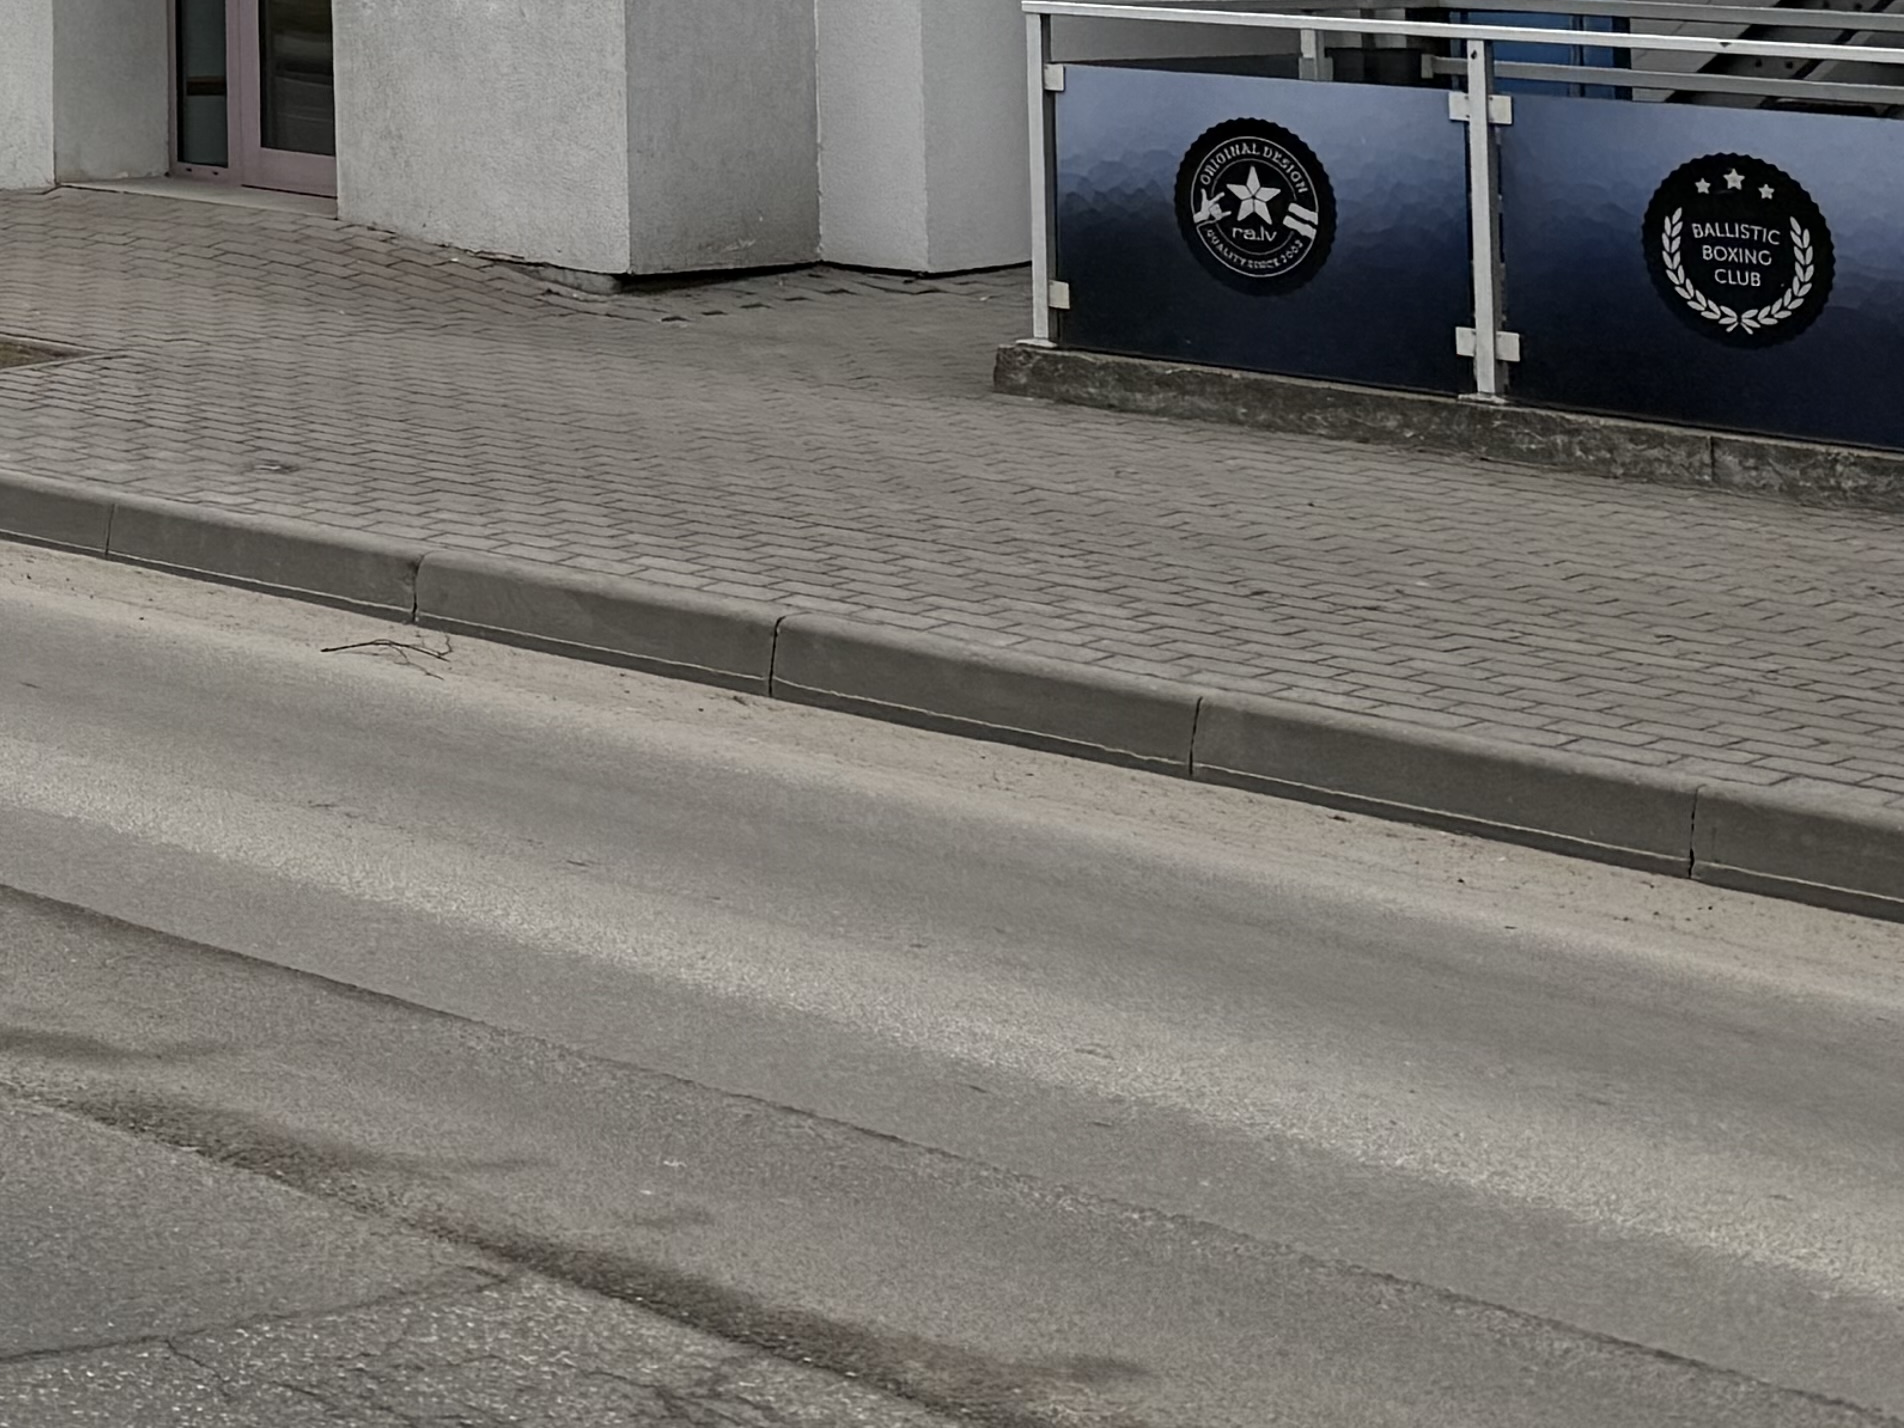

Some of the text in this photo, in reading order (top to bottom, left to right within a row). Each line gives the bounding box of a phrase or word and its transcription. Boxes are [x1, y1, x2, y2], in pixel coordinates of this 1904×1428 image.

[1199, 142, 1309, 194] ORIGINAL DESIGN
[1232, 225, 1278, 242] ra.lv
[1692, 222, 1781, 245] BALLISTIC
[1206, 228, 1249, 268] QUALITY
[1702, 244, 1773, 266] BOXING
[1714, 268, 1761, 287] CLUB
